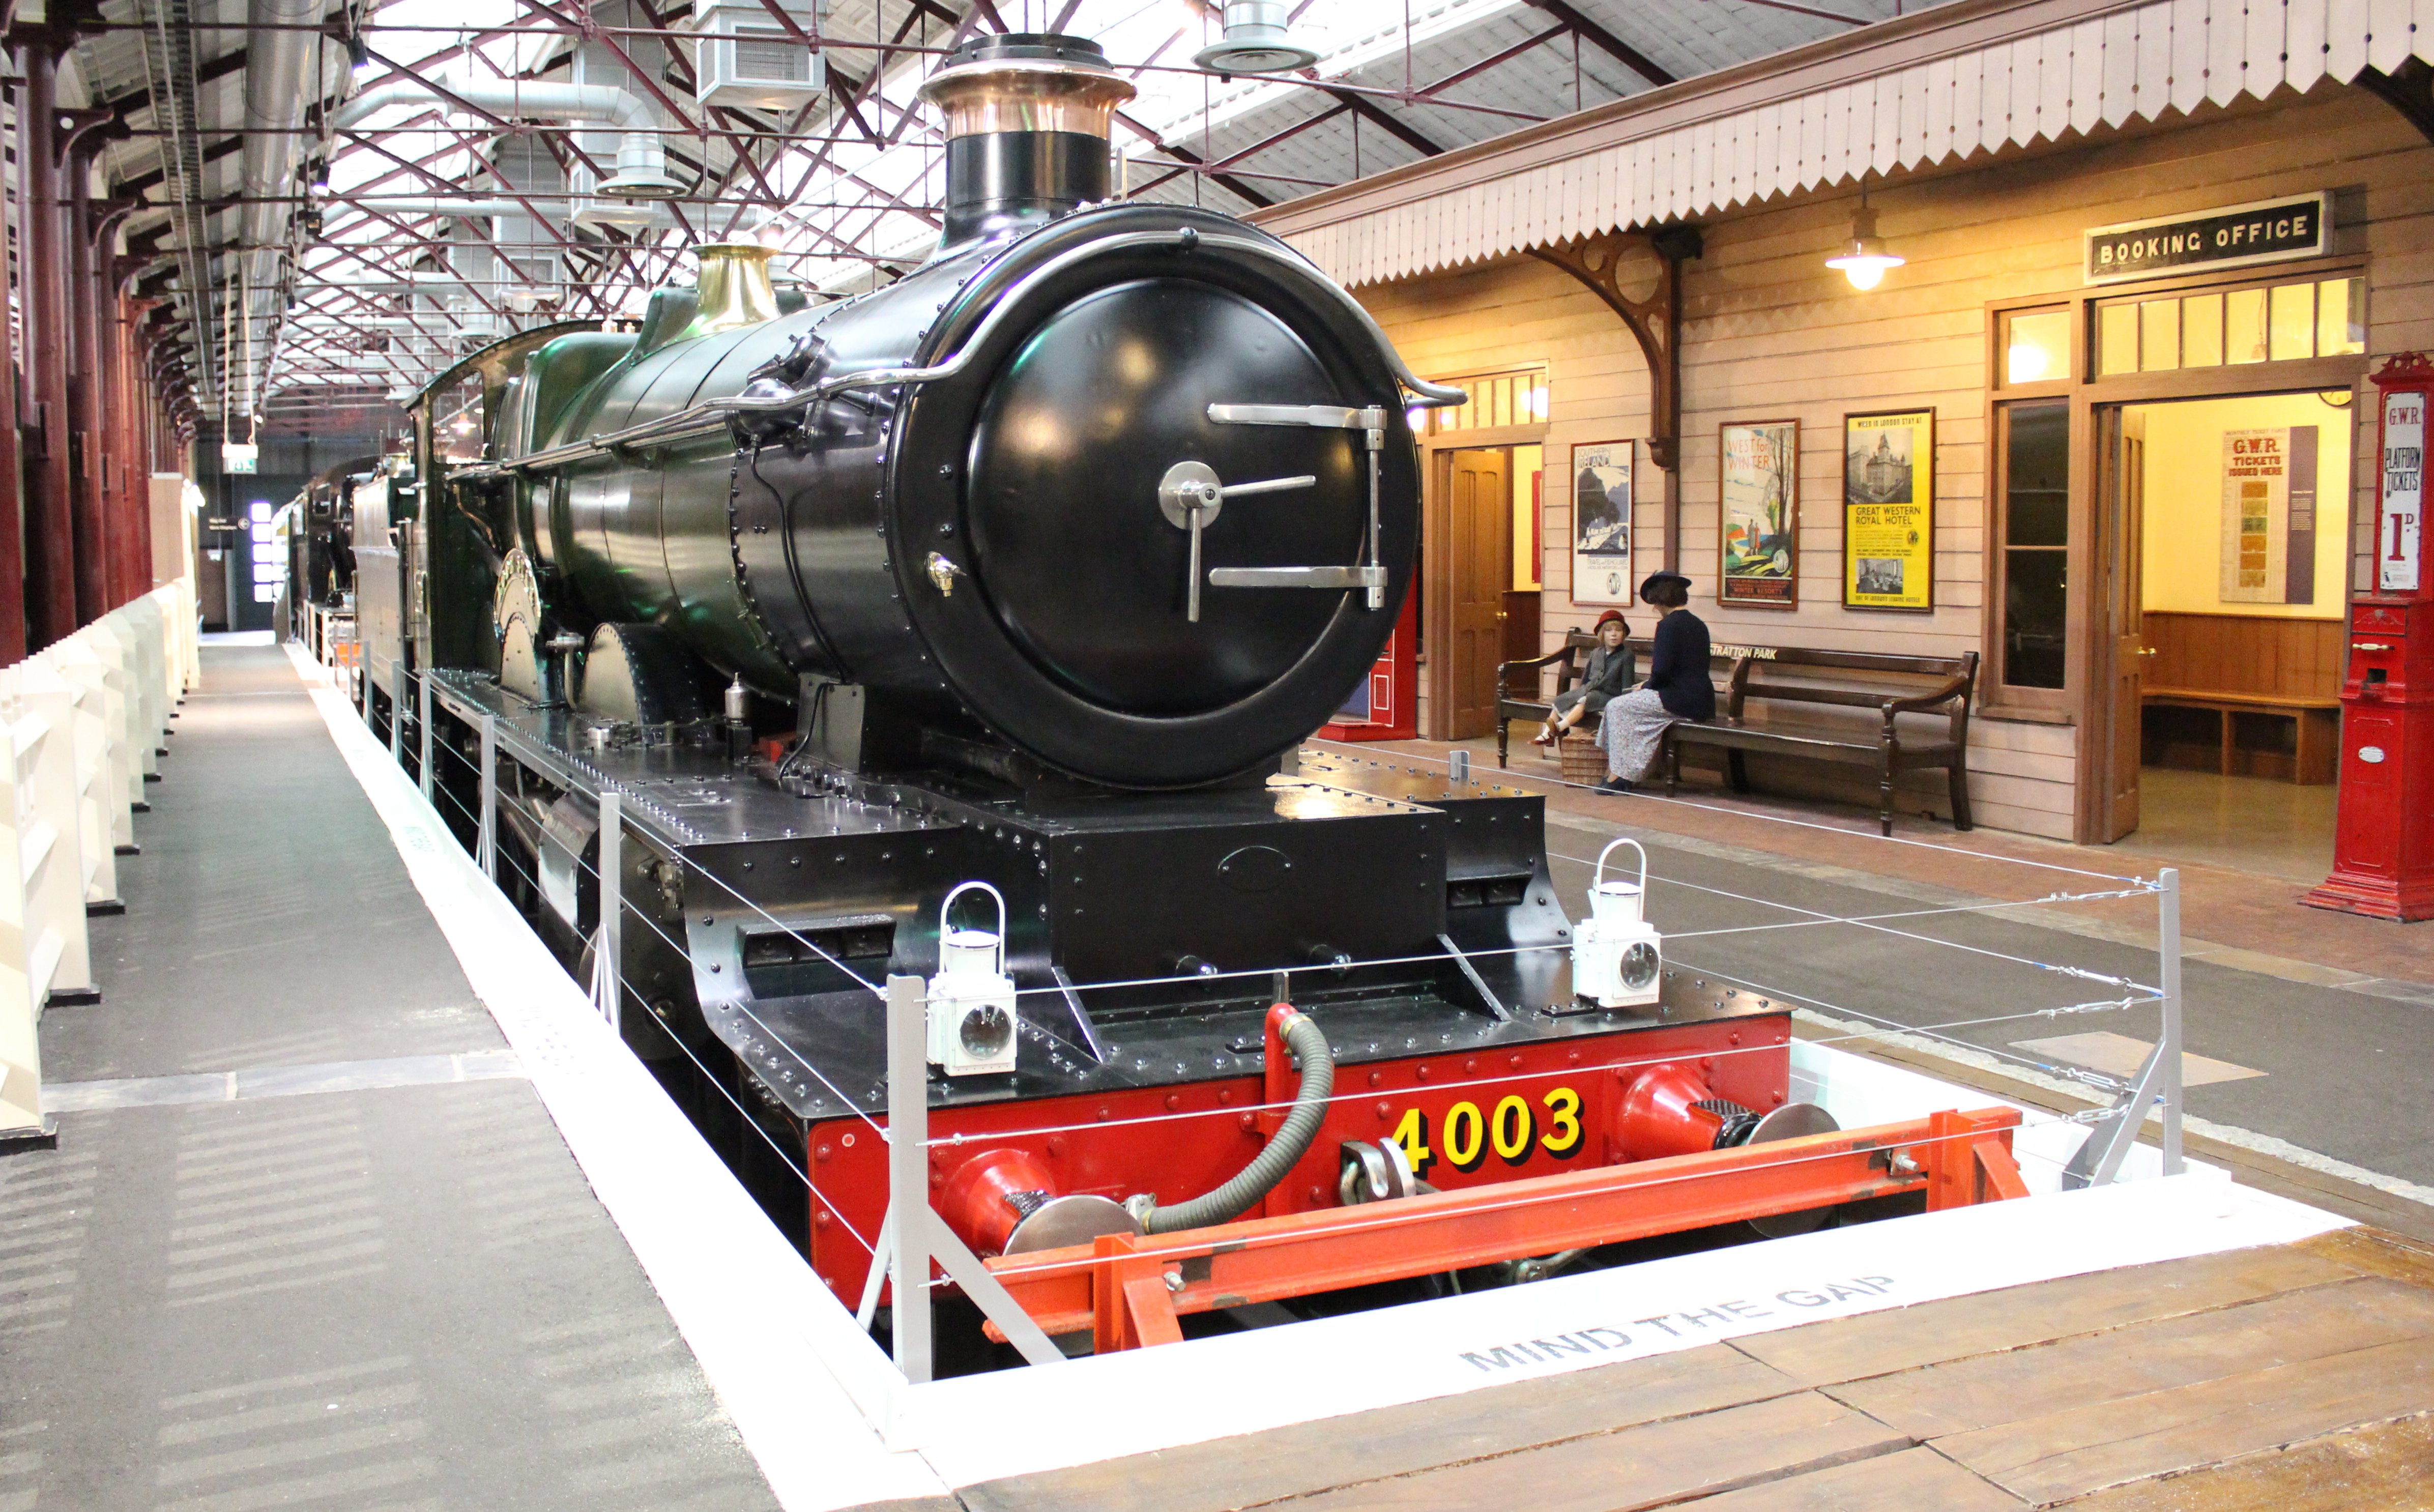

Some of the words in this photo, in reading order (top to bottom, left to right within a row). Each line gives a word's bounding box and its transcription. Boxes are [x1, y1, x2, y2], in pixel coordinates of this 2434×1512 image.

[2100, 232, 2201, 264] BOOKING
[2216, 215, 2308, 248] OFFICE
[1578, 447, 1611, 457] SOUTHERN
[1727, 439, 1755, 453] WEST
[1756, 438, 1768, 452] for
[2233, 438, 2280, 454] G.W.R.
[1578, 455, 1611, 468] IRELAND
[1728, 455, 1770, 470] WINTER
[2233, 456, 2280, 466] TICKETS
[2385, 447, 2420, 469] PLATFORM
[2261, 467, 2282, 476] HERE
[2386, 471, 2418, 491] TICKETS
[1856, 507, 1880, 515] GREAT
[1883, 506, 1920, 515] WESTERN
[1857, 516, 1881, 525] ROYAL
[1886, 515, 1913, 525] HOTEL
[1607, 573, 1620, 594] GWR
[1754, 648, 1777, 660] PARK
[1391, 1087, 1585, 1180] 4003
[1459, 1328, 1633, 1372] MIND
[1631, 1295, 1775, 1337] THE
[1776, 1276, 1895, 1306] GAP
